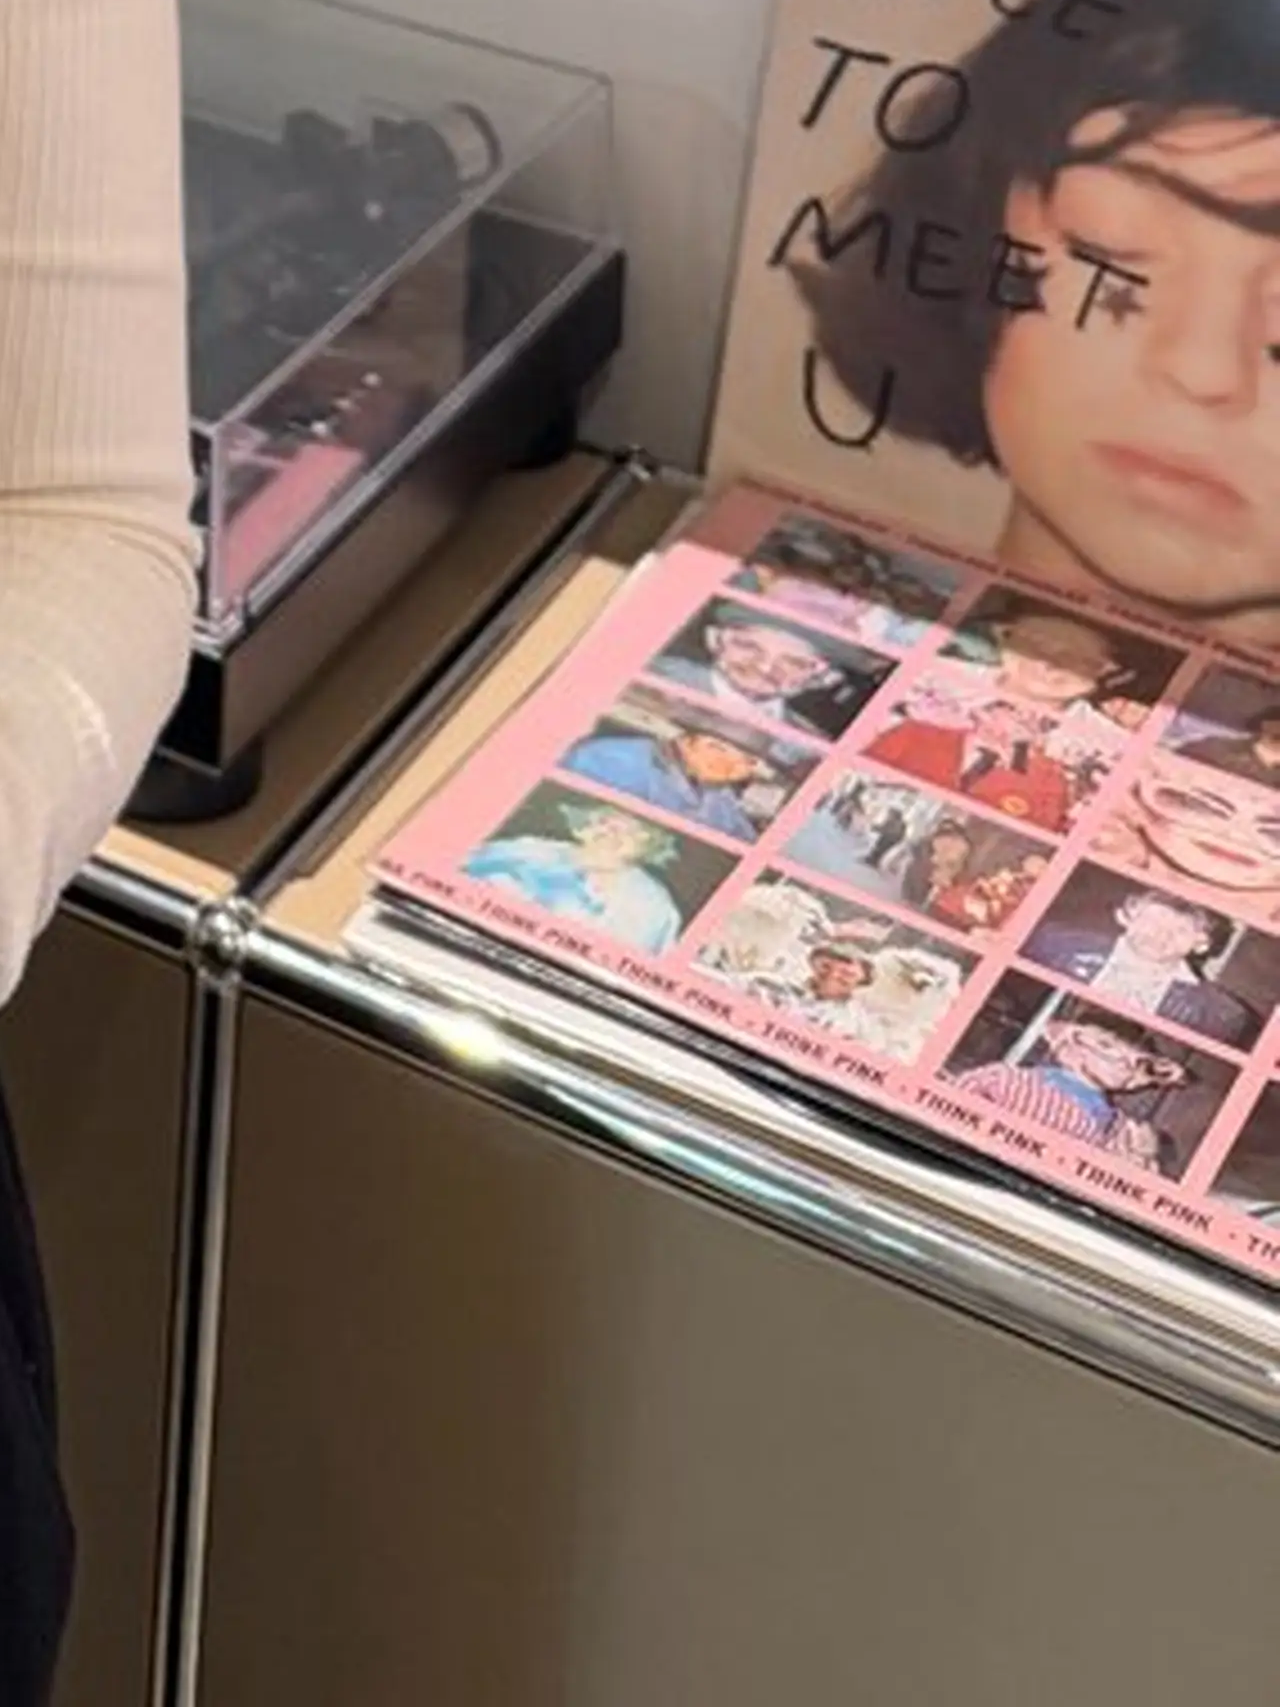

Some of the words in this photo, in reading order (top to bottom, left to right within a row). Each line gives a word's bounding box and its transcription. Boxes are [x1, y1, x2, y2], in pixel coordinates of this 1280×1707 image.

[800, 36, 970, 152] TO
[766, 196, 1152, 331] MEET
[802, 347, 896, 455] U
[990, 1120, 1049, 1159] PINK
[1152, 1195, 1214, 1234] PINK
